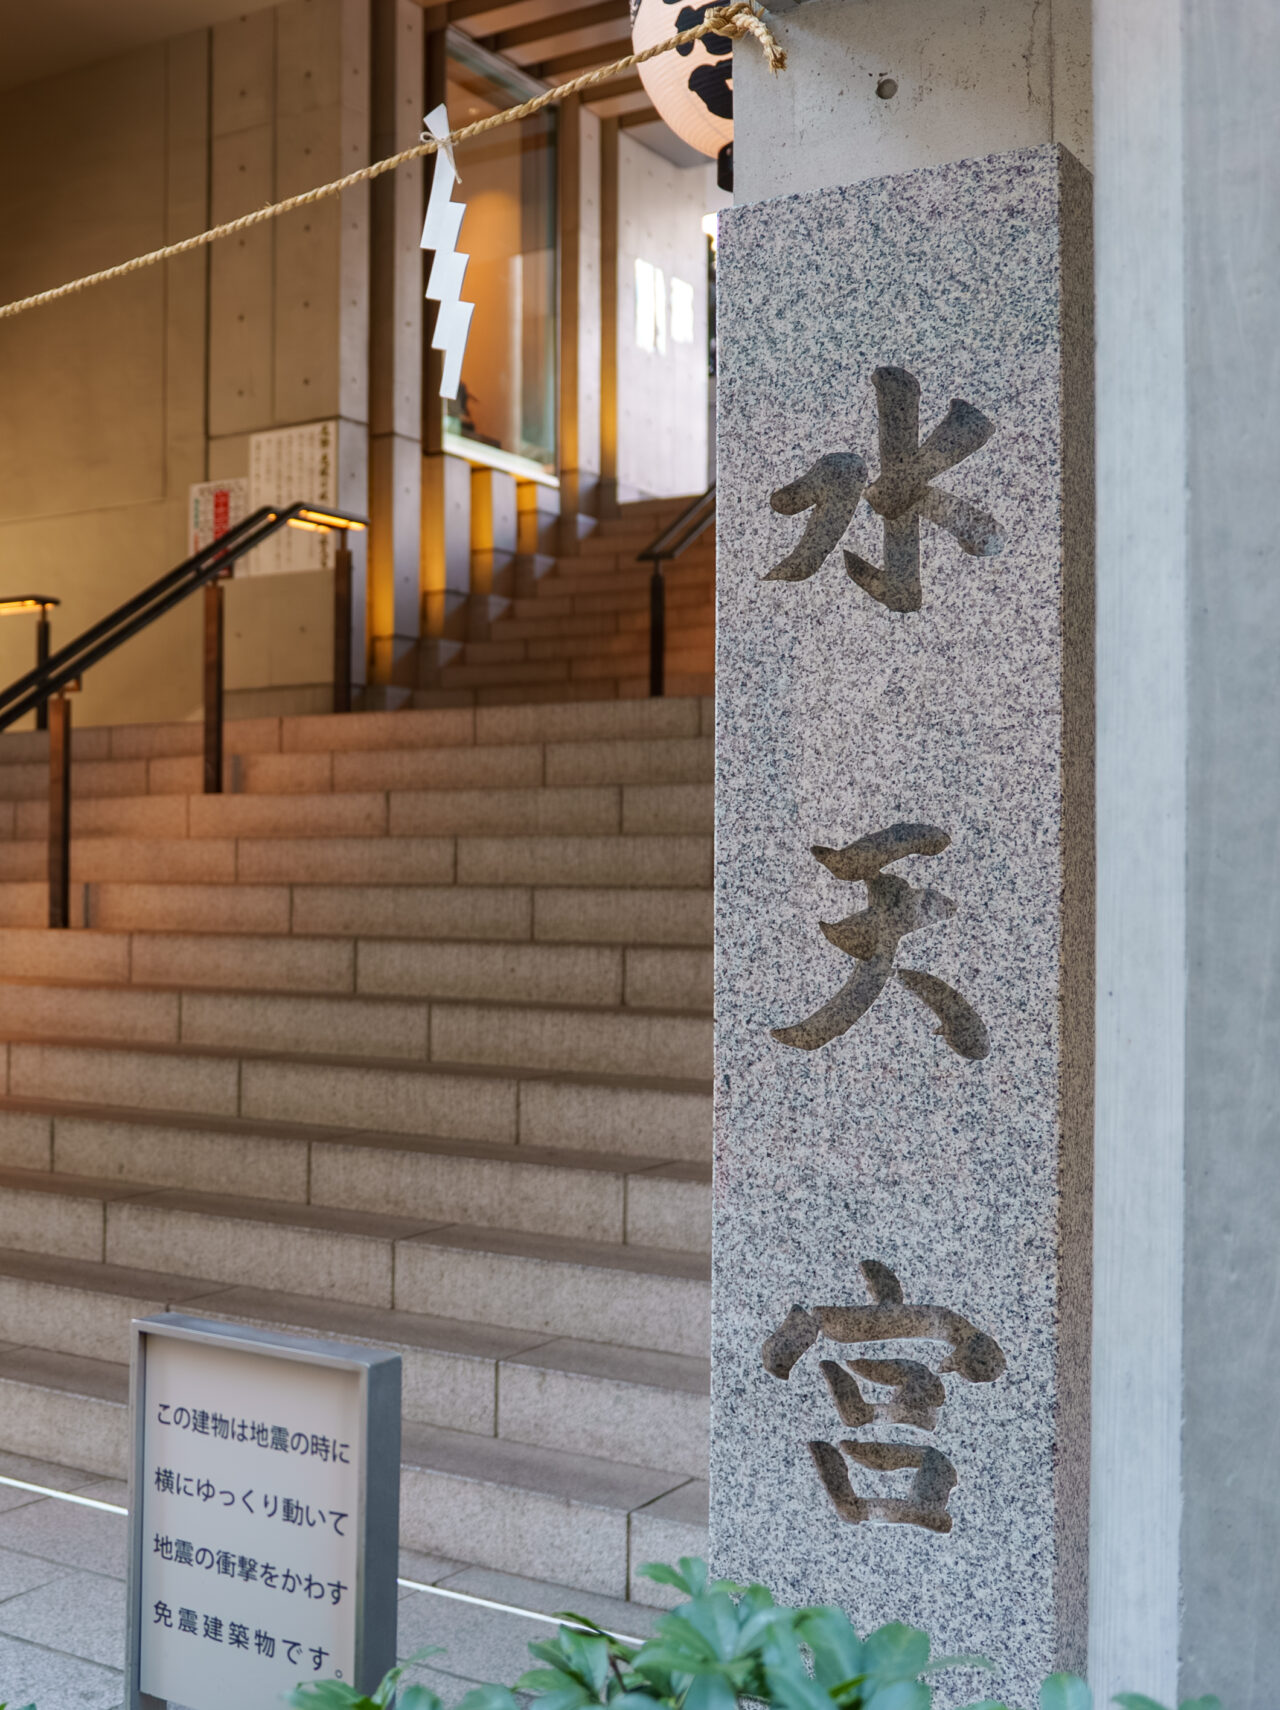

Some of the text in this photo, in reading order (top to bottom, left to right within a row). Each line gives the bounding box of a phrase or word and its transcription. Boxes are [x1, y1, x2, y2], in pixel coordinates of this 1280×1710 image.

[760, 366, 1007, 1535] 水天宮
[156, 1403, 351, 1465] この建物は地震の時に
[154, 1466, 350, 1537] 横にゆっくり動いて
[153, 1533, 349, 1606] 地震の衝撃をかわす
[153, 1600, 344, 1680] 免震建築物です。
